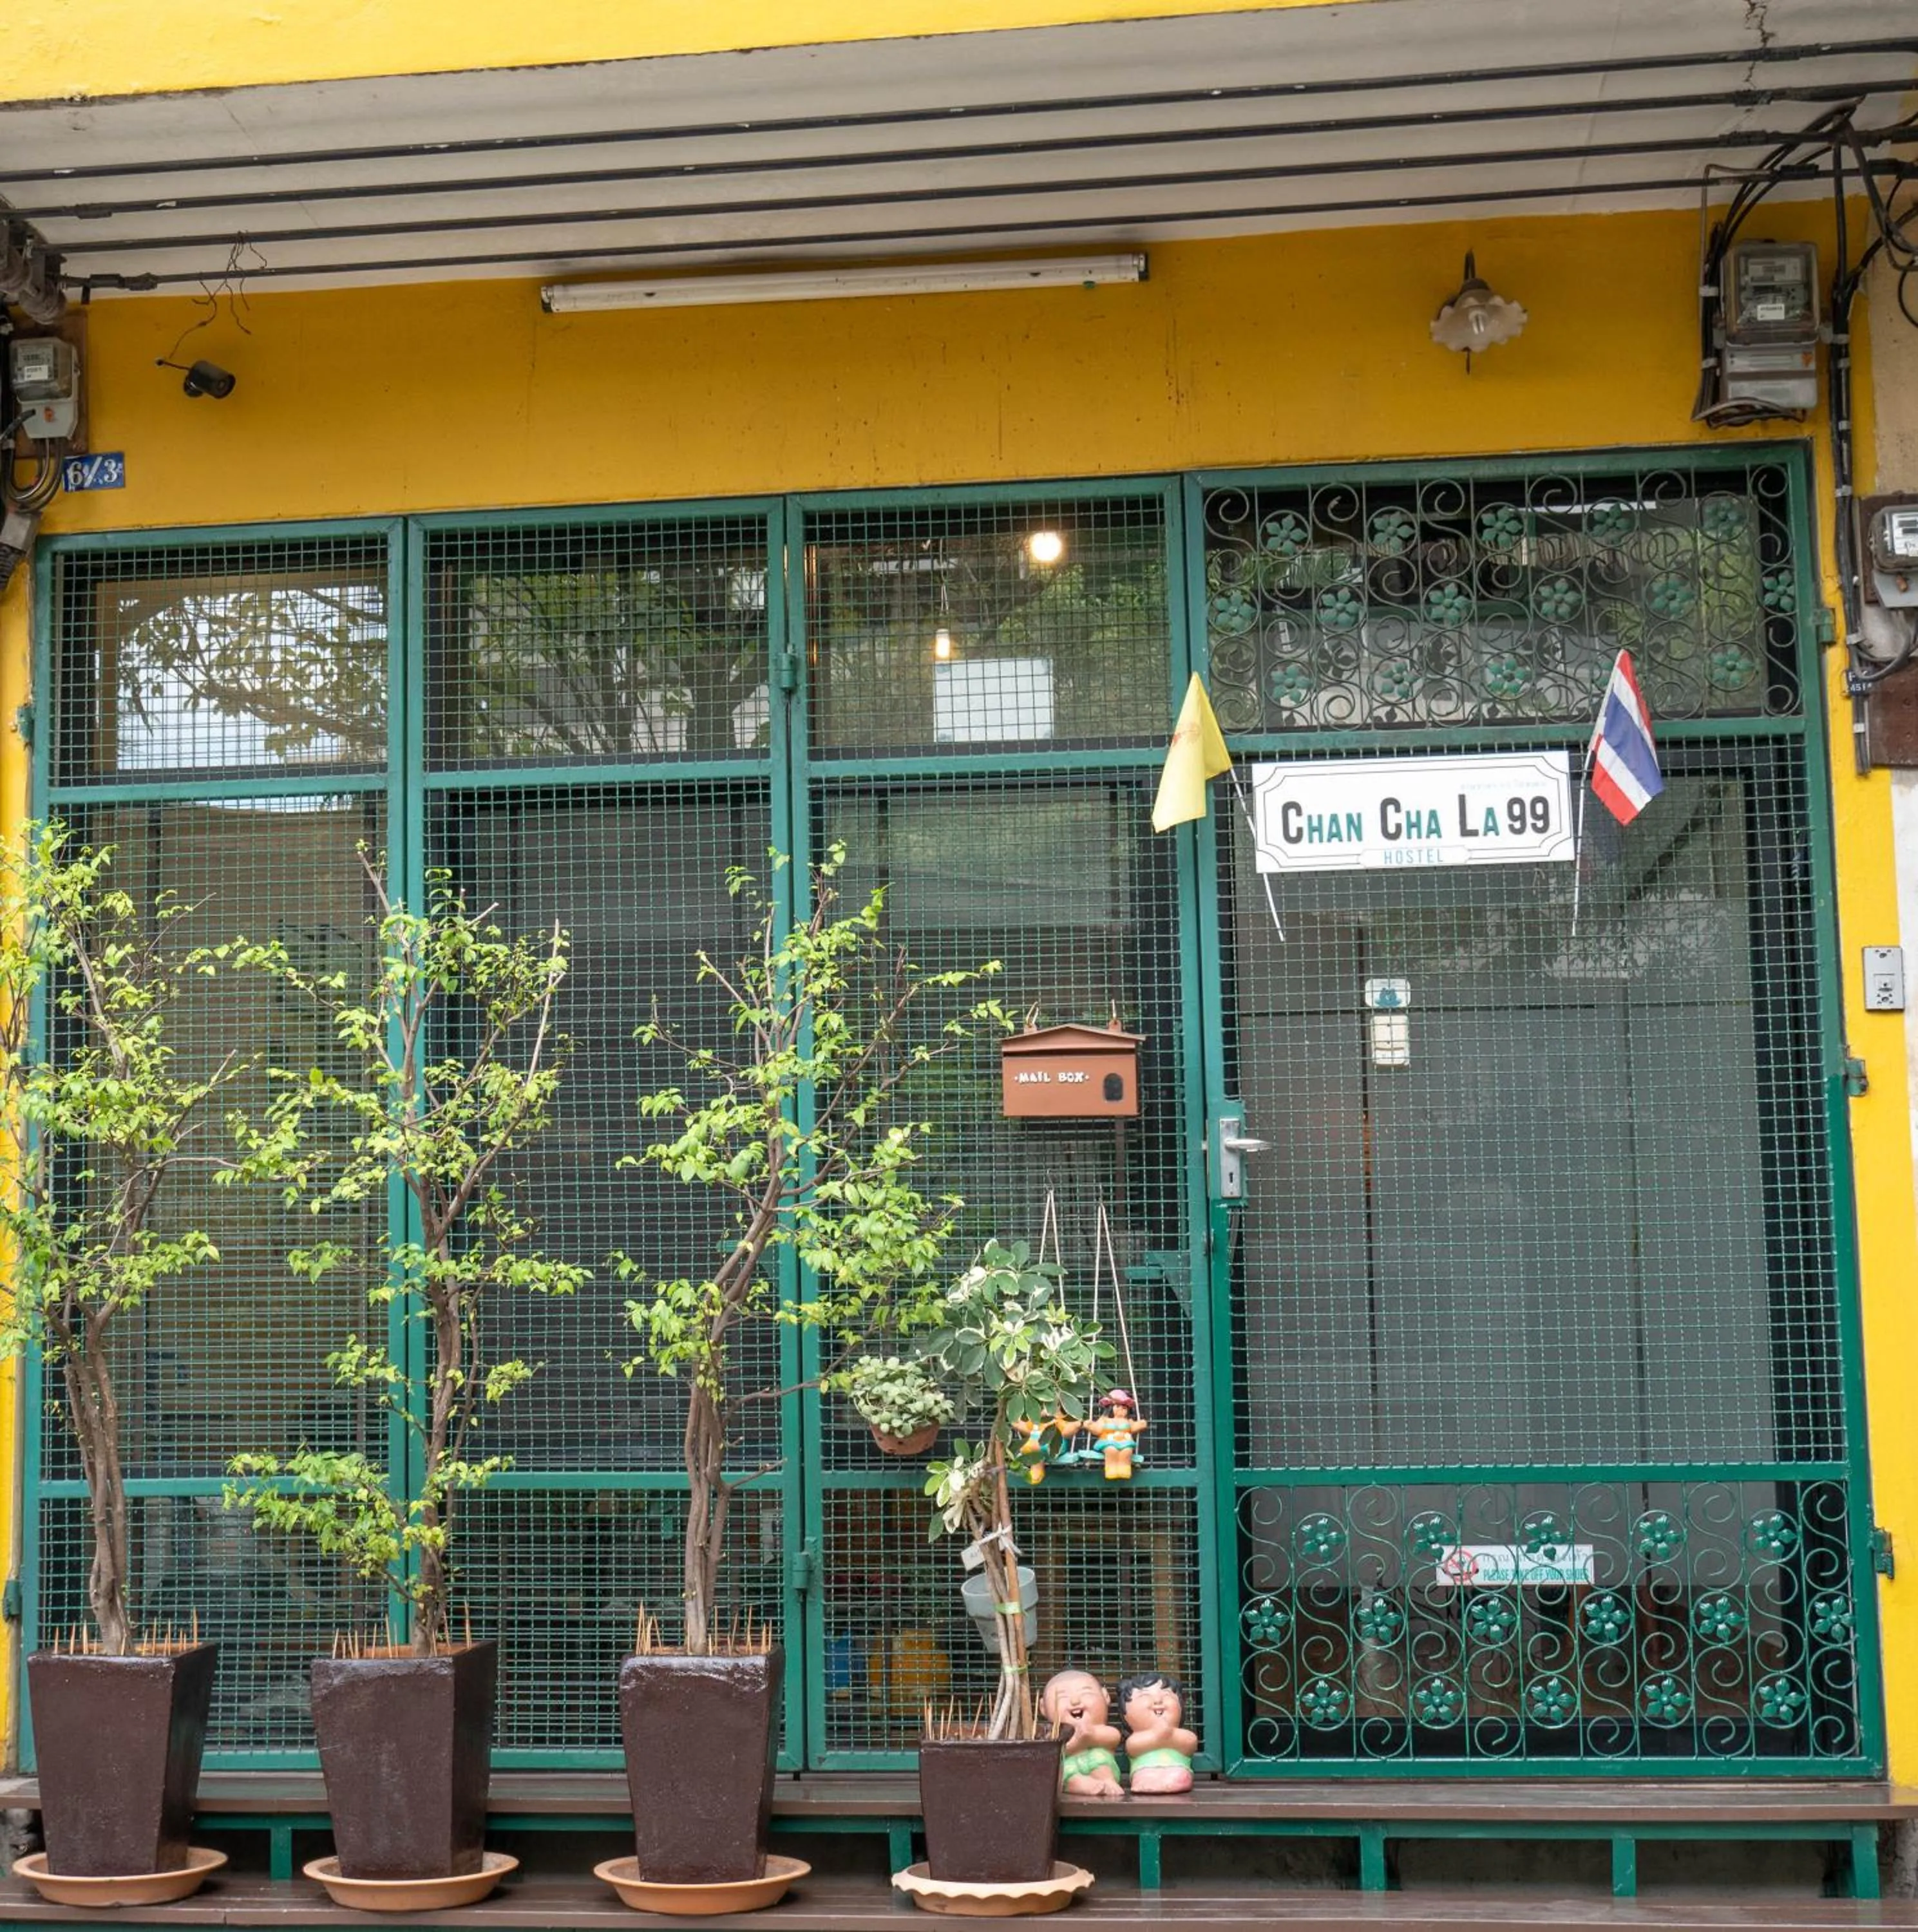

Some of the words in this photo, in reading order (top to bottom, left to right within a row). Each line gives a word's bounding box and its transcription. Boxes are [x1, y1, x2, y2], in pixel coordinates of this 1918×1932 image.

[1282, 801, 1363, 844] CHAN
[1380, 797, 1442, 840] CHA
[1384, 848, 1444, 865] HOSTEL
[1483, 1568, 1510, 1581] PLEASE
